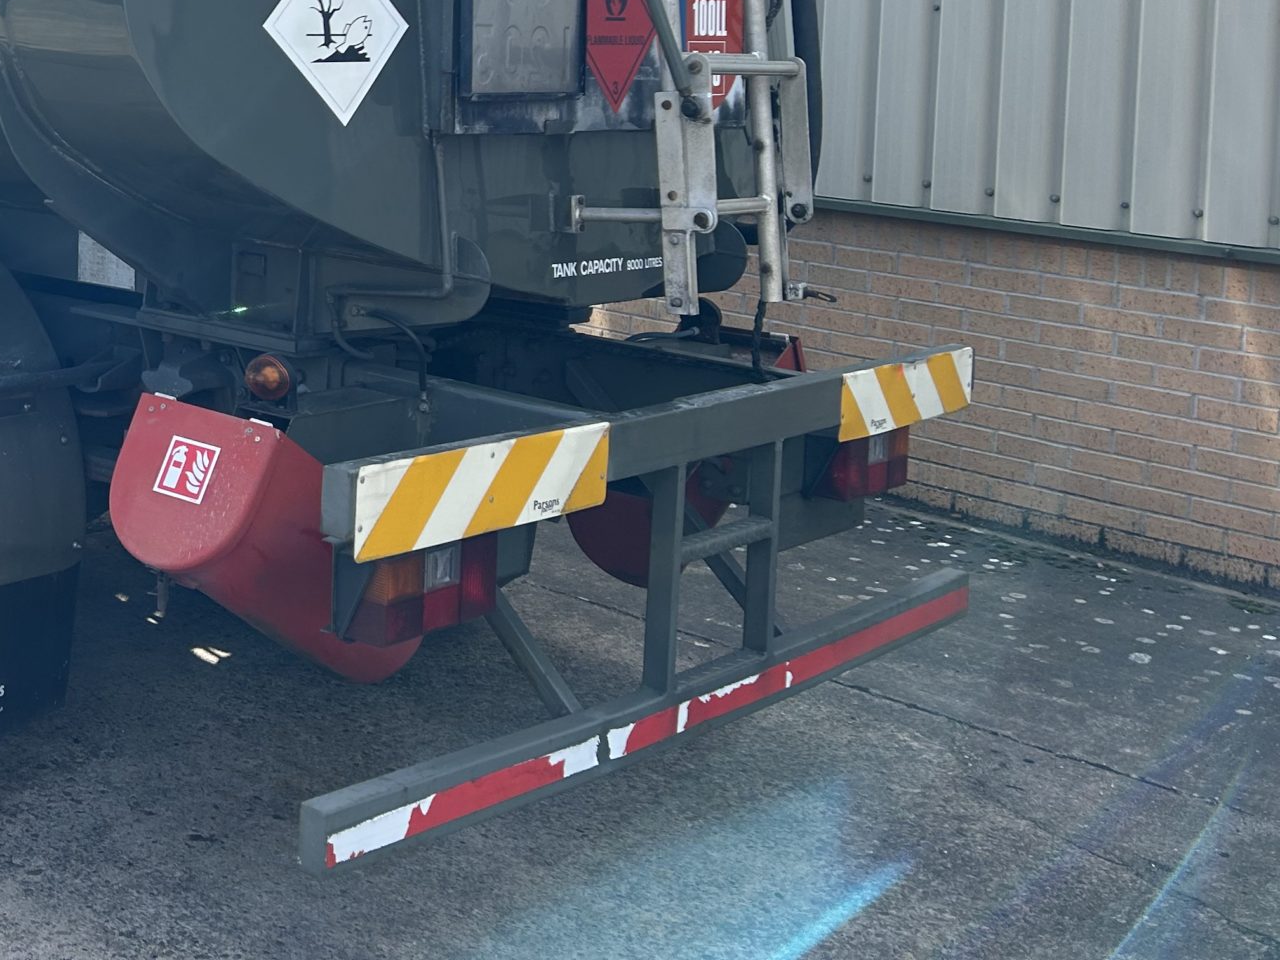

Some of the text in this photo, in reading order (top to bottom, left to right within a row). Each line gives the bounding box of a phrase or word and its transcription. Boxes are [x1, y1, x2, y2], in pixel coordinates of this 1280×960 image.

[612, 81, 619, 95] 3
[552, 262, 577, 278] TANK
[580, 257, 624, 275] CAPACITY
[533, 498, 560, 511] Parsons
